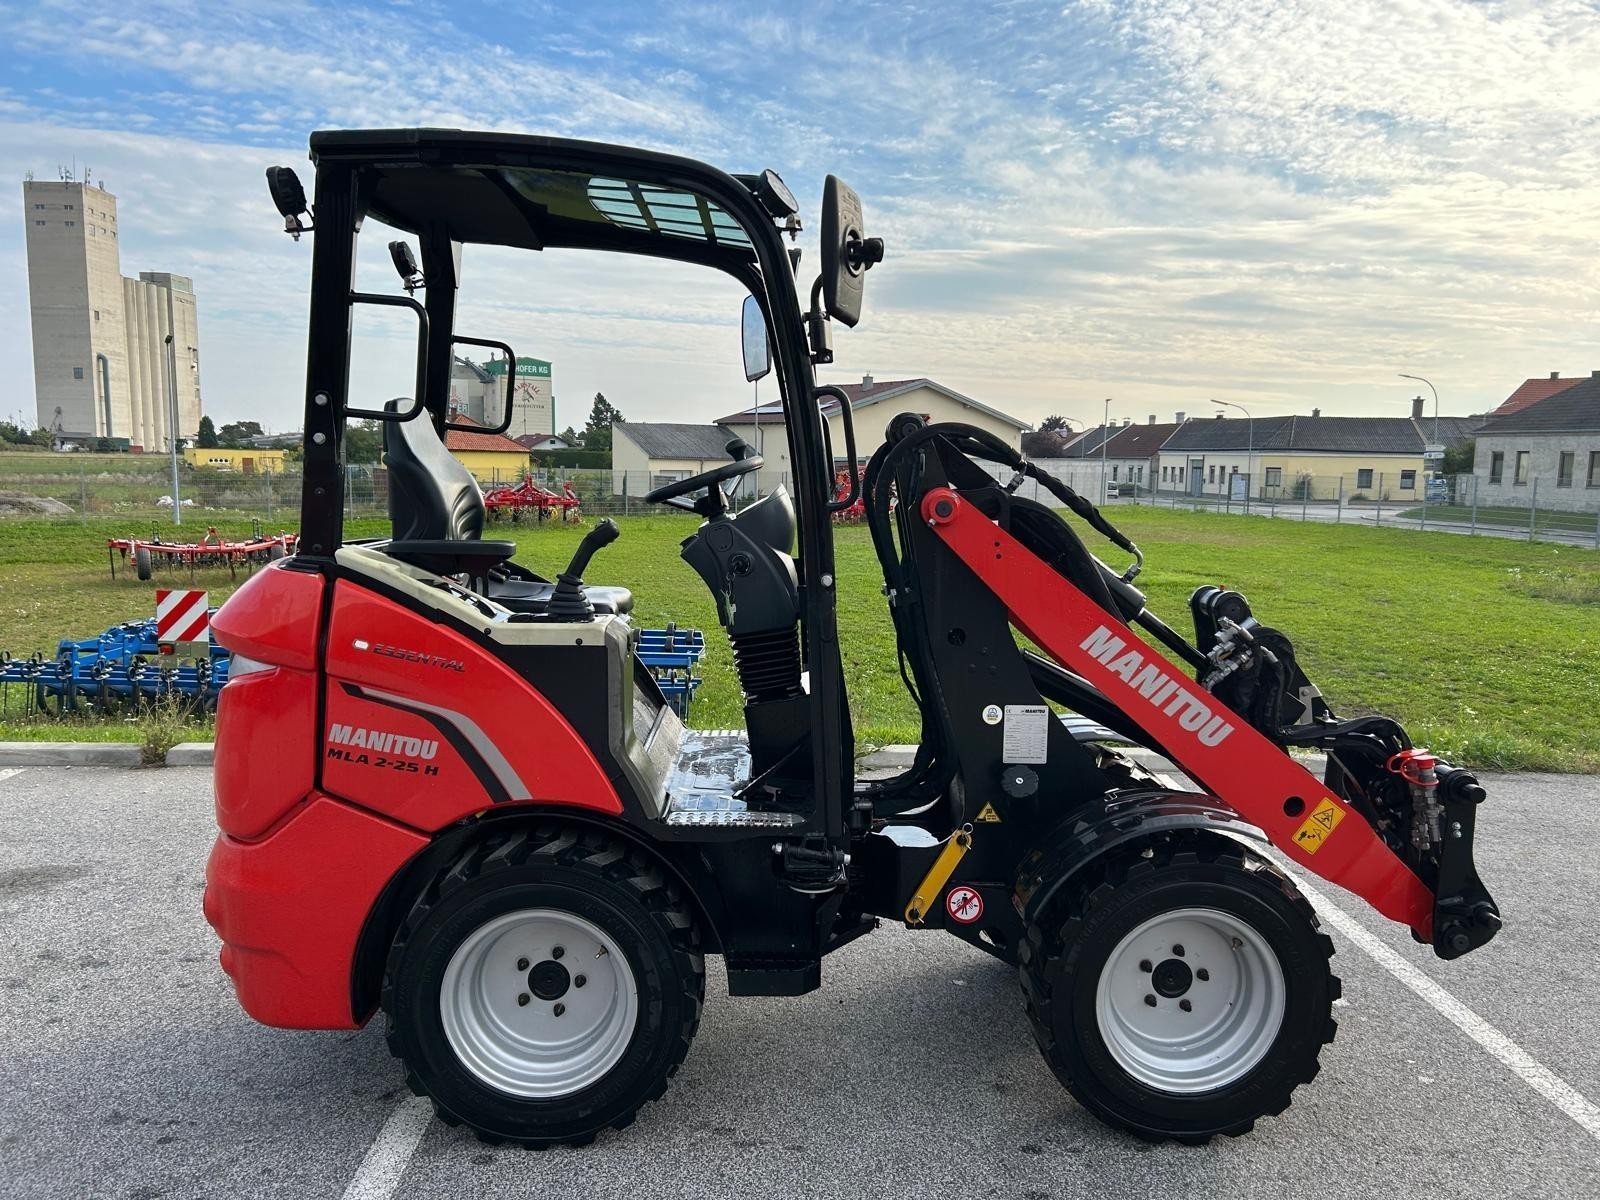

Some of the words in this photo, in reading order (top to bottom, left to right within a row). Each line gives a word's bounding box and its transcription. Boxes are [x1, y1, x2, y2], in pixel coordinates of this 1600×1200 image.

[539, 366, 548, 374] KG
[373, 643, 465, 673] ESSENTIAL
[1079, 624, 1235, 747] MANITOU
[328, 723, 439, 760] MANITOU
[327, 748, 369, 765] MLA
[374, 757, 419, 773] 2-25
[424, 765, 439, 776] H
